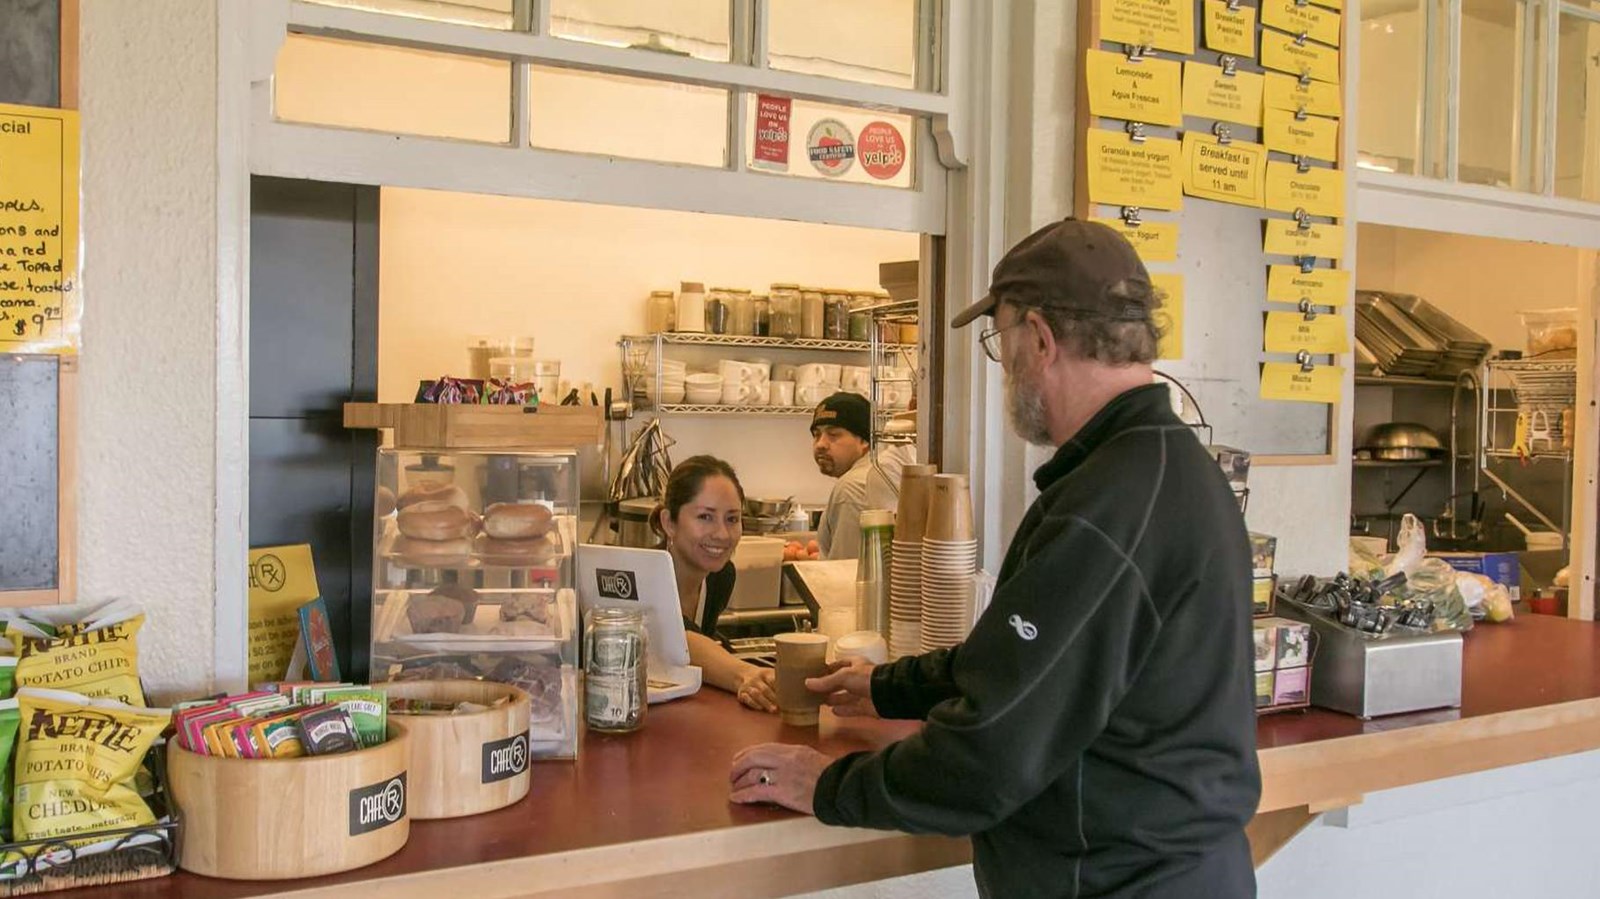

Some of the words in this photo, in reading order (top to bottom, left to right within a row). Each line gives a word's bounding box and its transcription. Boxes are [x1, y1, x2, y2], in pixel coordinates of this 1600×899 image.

[1215, 11, 1245, 26] Breakfast
[1217, 23, 1243, 36] Pastries
[1115, 66, 1153, 79] Lemonade
[1132, 80, 1138, 89] &
[1214, 80, 1237, 92] Sweets
[1111, 89, 1130, 99] Agua
[1131, 92, 1160, 104] Frescas
[761, 103, 787, 113] PEOPLE
[760, 112, 778, 121] LOVE
[778, 113, 787, 121] US
[868, 127, 892, 135] PEOPLE
[1288, 125, 1314, 137] Espresso
[865, 135, 884, 143] LOVE
[886, 135, 896, 144] US
[809, 148, 829, 156] FOOD
[829, 144, 853, 154] SAFETY
[1101, 145, 1131, 157] Granola
[1132, 149, 1145, 159] and
[1147, 153, 1170, 163] yogurt
[1200, 145, 1242, 164] Breakfast
[1242, 155, 1250, 165] is
[864, 151, 893, 167] yelp
[1199, 164, 1228, 176] served
[1230, 167, 1249, 179] until
[1212, 179, 1221, 190] 11
[1223, 183, 1237, 192] am
[1290, 181, 1320, 192] Chocolate
[35, 225, 59, 236] and
[1137, 231, 1159, 241] Yogurt
[23, 241, 46, 256] red
[1292, 278, 1323, 288] Americano
[54, 647, 97, 665] BRAND
[23, 667, 83, 686] POTATO
[88, 657, 130, 674] CHIPS
[610, 707, 622, 717] 10
[26, 708, 142, 753] KETTLE
[27, 760, 84, 774] POTATO
[49, 788, 74, 798] NEW
